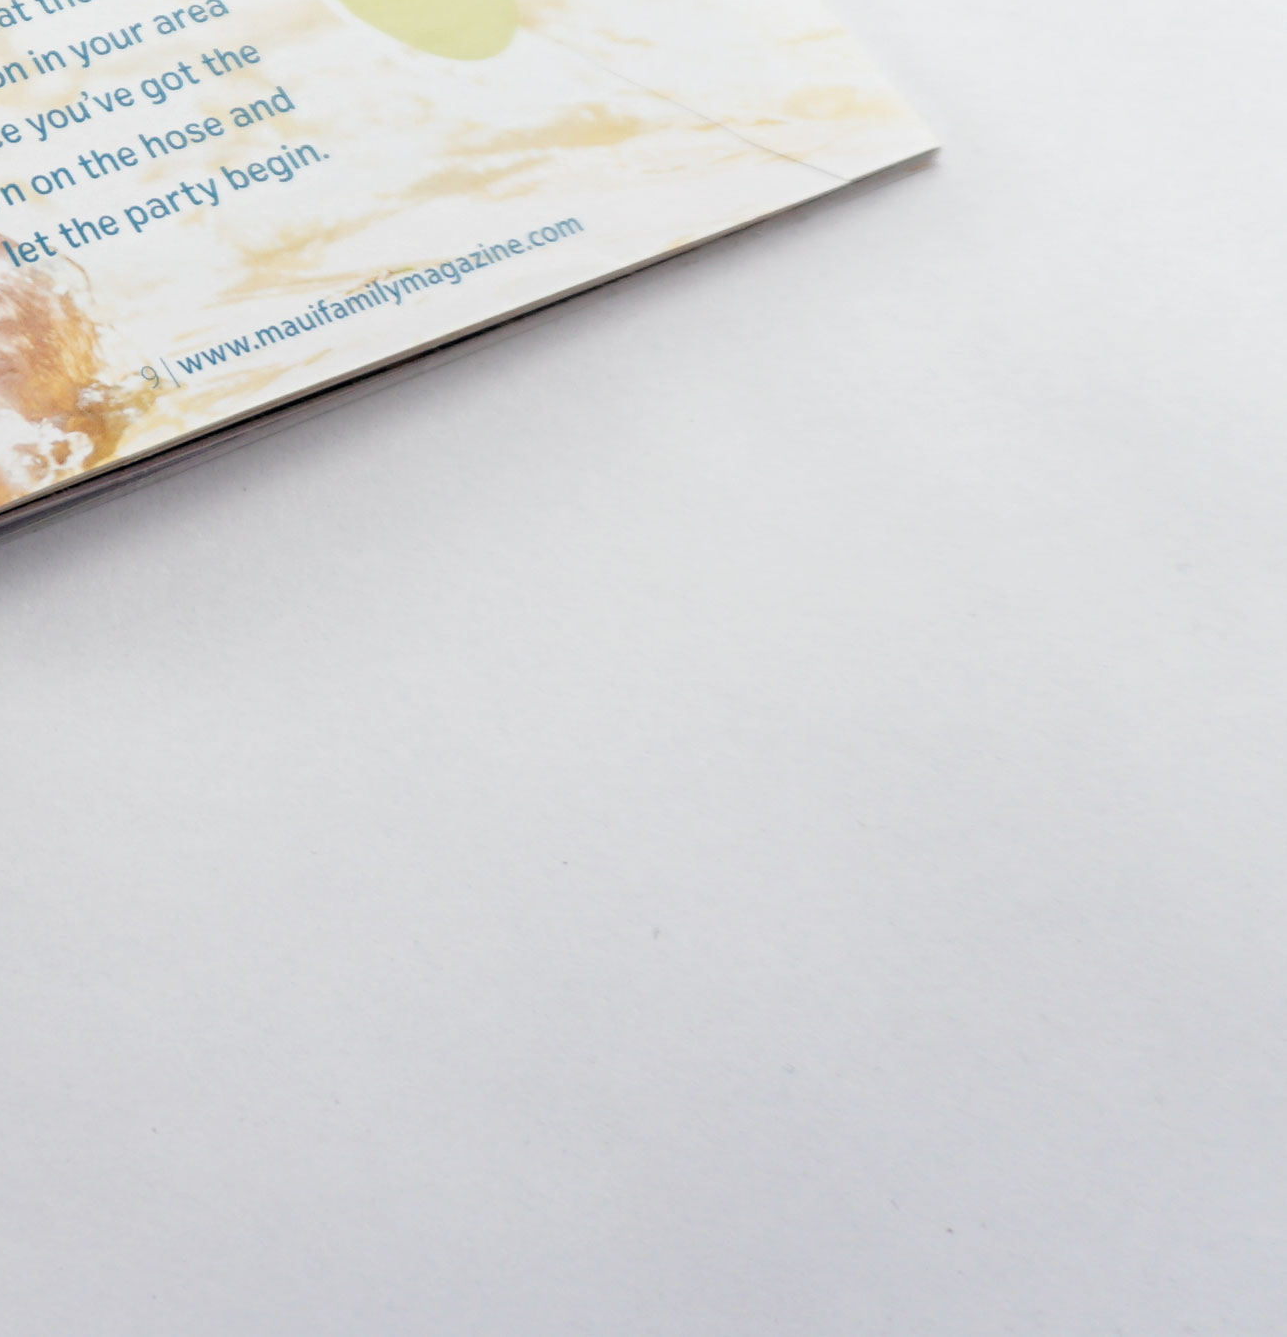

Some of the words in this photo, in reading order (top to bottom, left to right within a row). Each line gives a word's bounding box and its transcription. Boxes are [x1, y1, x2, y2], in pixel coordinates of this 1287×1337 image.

[28, 50, 66, 73] in
[75, 22, 143, 69] your
[141, 63, 200, 105] got
[202, 41, 261, 78] the
[31, 167, 76, 195] on
[79, 147, 139, 179] the
[139, 120, 224, 159] hose
[234, 90, 295, 127] and
[4, 231, 57, 267] let
[58, 216, 120, 249] the
[124, 179, 220, 233] party
[219, 139, 330, 192] begin.
[140, 365, 160, 389] 9
[178, 215, 584, 375] www.mauifamilymagazine.com
